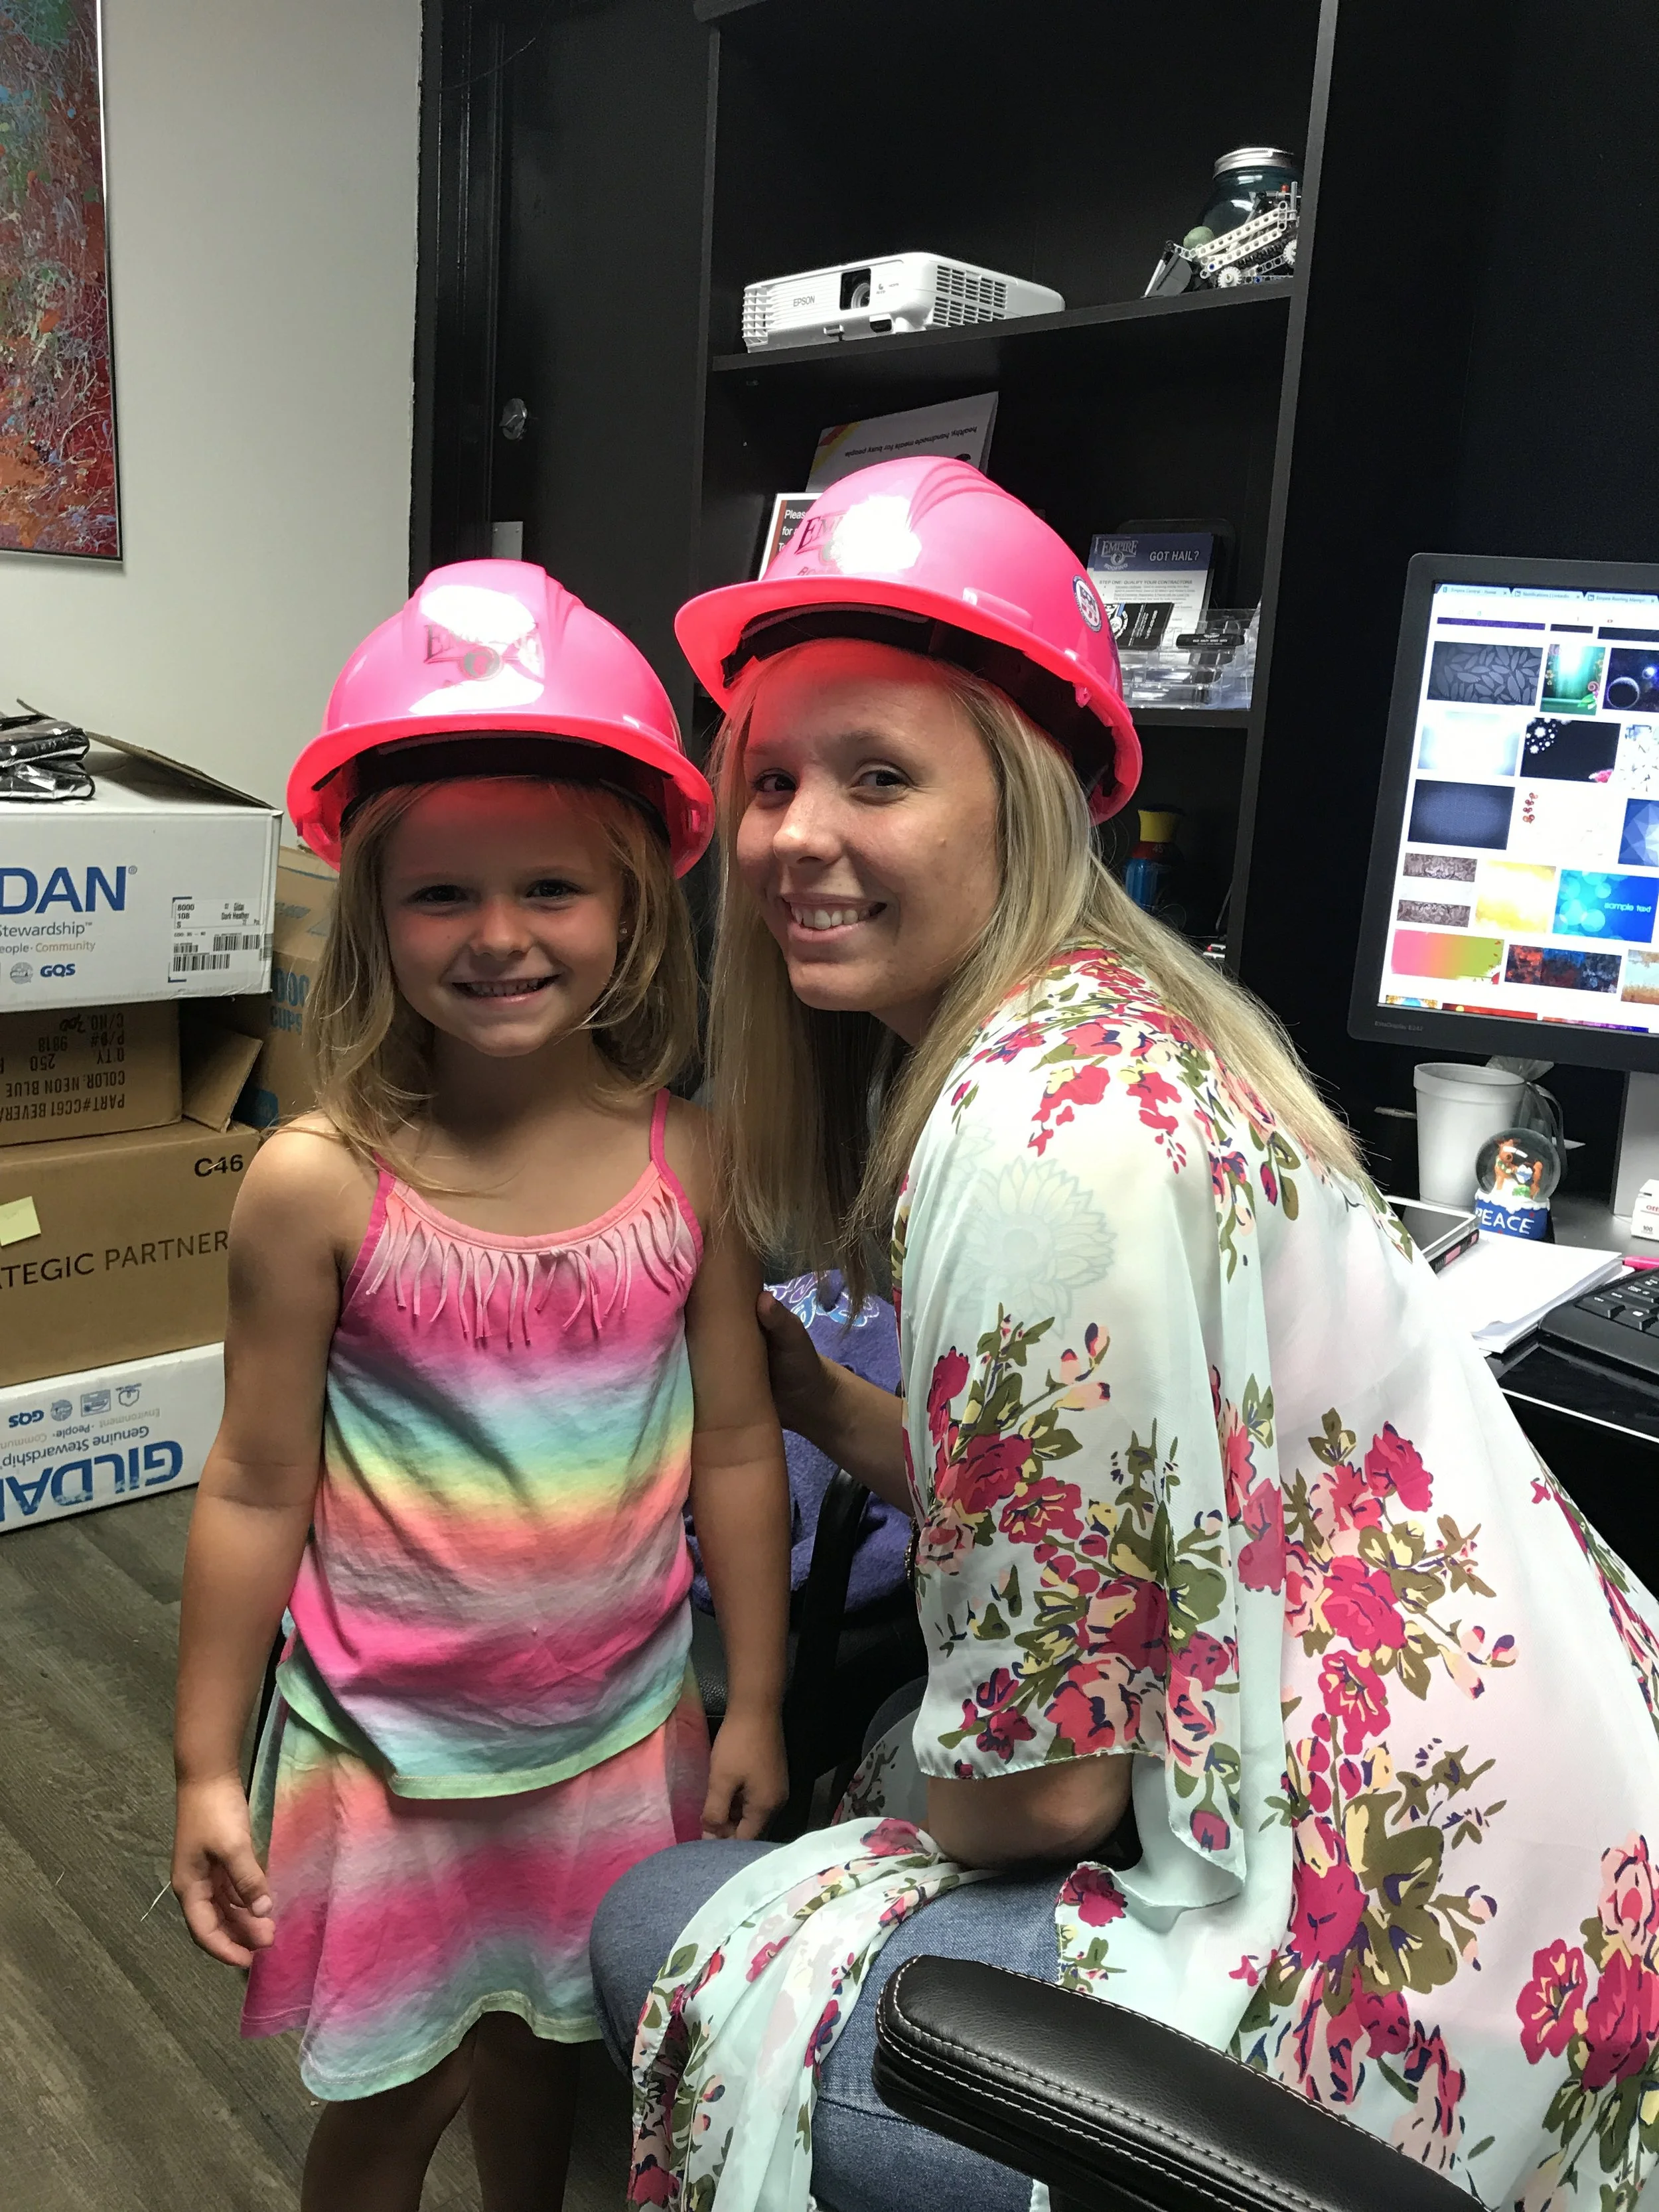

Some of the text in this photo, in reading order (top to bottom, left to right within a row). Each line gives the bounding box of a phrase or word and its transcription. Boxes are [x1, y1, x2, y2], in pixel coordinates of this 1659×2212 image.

[793, 295, 816, 307] EPSON
[784, 510, 806, 520] Pleas
[782, 526, 794, 536] for
[1102, 540, 1139, 557] EMPIRE
[1149, 550, 1200, 561] GOT HAIL?
[36, 940, 96, 952] Community
[40, 963, 76, 978] GQS
[30, 1053, 56, 1071] 250
[5, 1080, 40, 1097] BLUE
[44, 1076, 80, 1094] NEON
[1475, 1207, 1535, 1234] PEACE
[0, 1230, 228, 1290] TEGIC PARTNER
[9, 1410, 44, 1428] GQS
[100, 1408, 161, 1428] Environment
[93, 1425, 149, 1445] Genuine
[0, 1440, 183, 1522] GILDA
